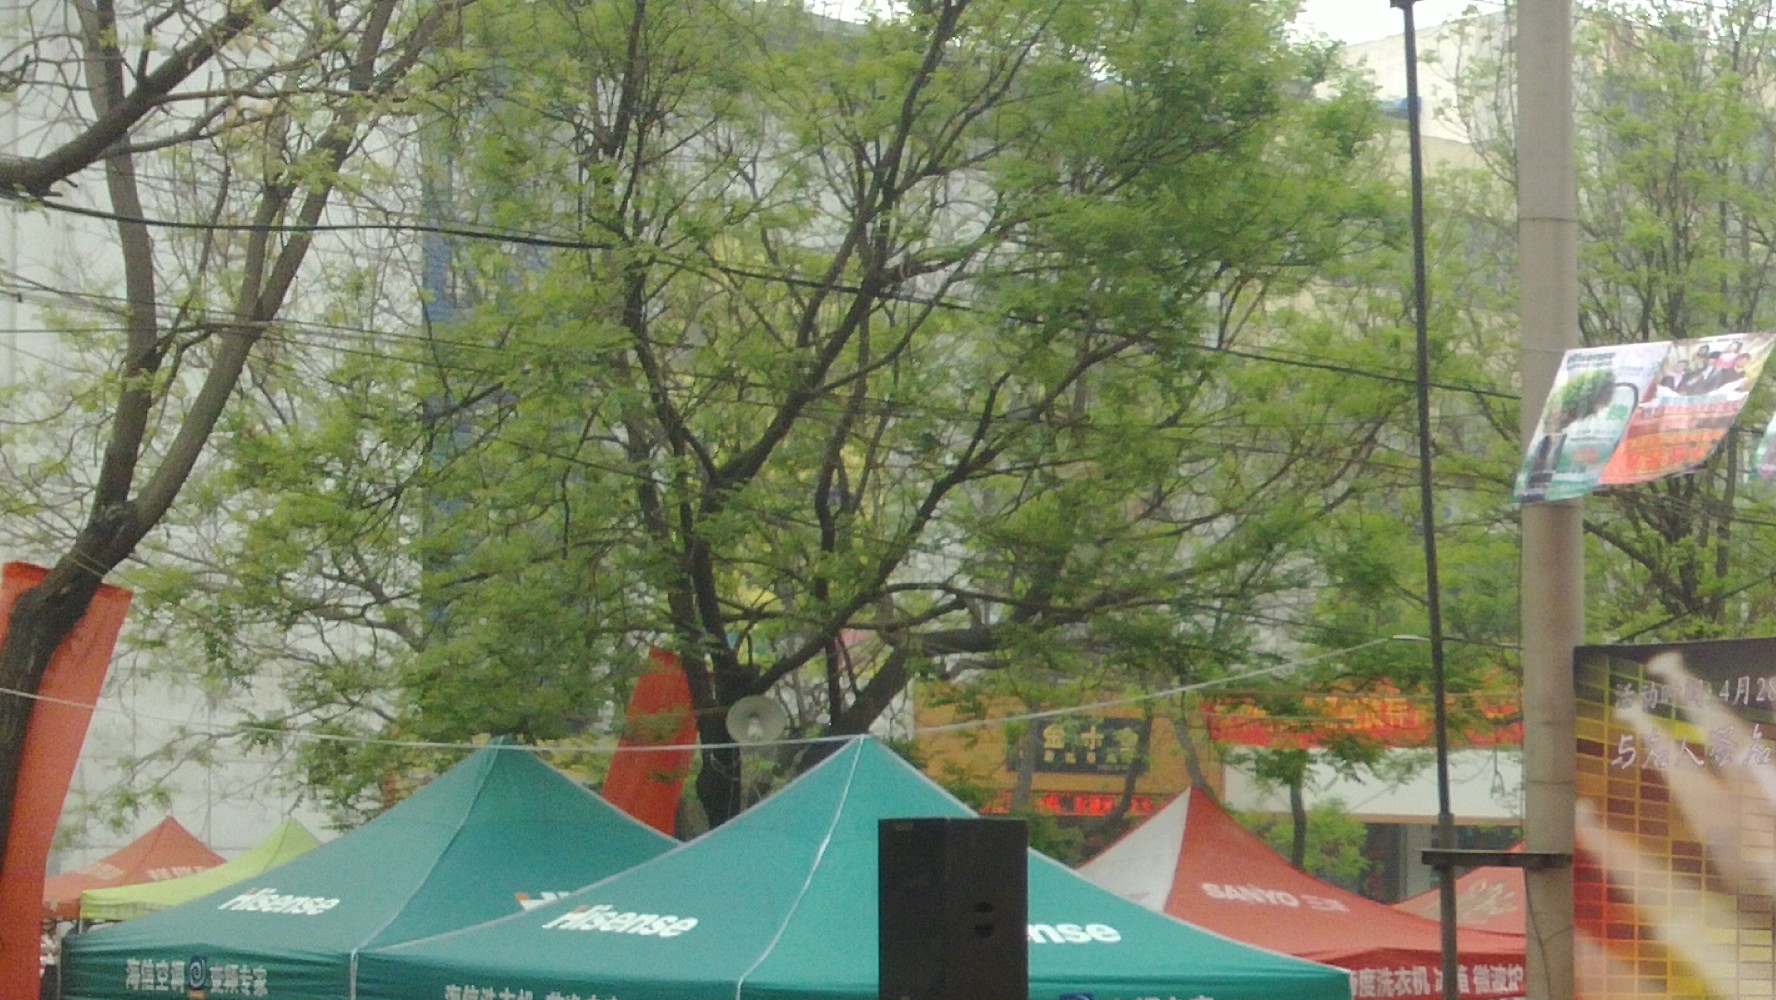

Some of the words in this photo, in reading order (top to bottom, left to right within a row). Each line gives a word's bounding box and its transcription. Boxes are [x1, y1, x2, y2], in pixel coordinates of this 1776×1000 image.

[217, 887, 341, 916] Hisense
[1201, 882, 1300, 908] SANYO
[541, 904, 699, 938] Hisense
